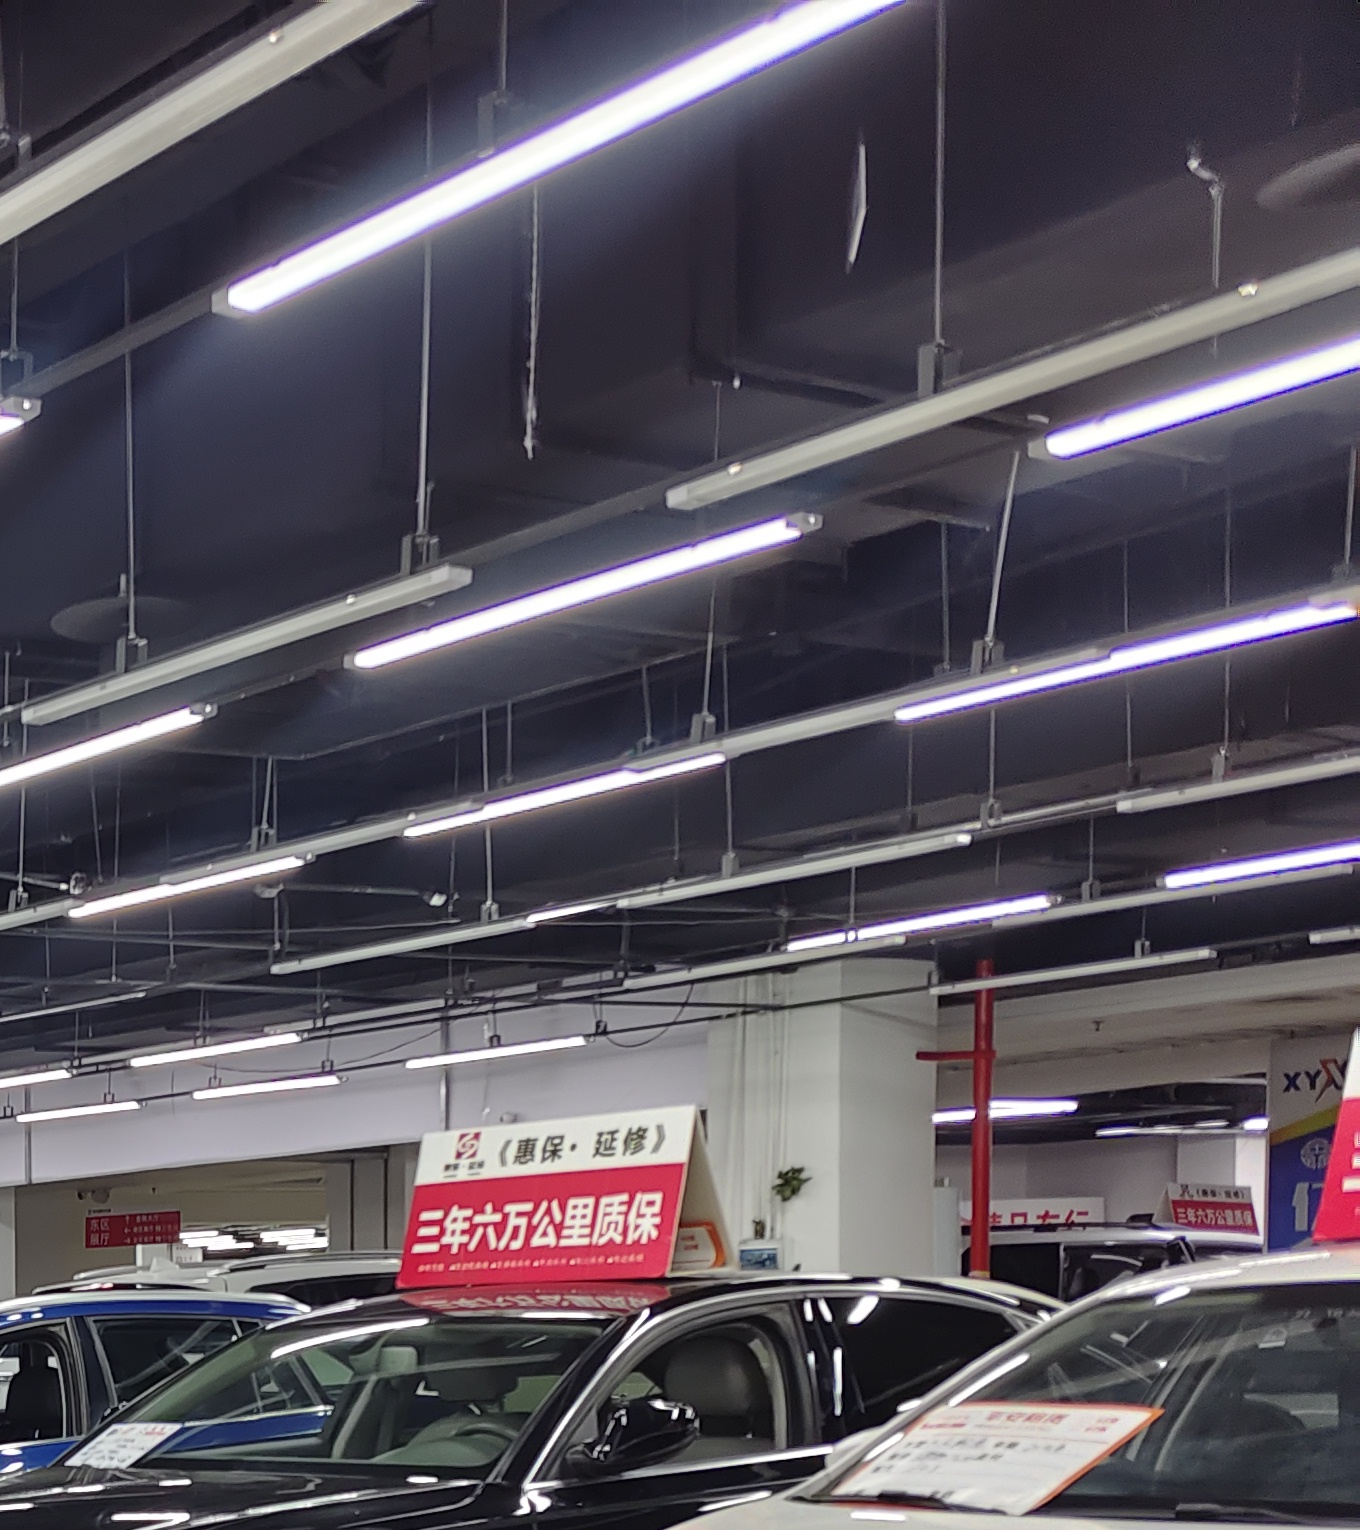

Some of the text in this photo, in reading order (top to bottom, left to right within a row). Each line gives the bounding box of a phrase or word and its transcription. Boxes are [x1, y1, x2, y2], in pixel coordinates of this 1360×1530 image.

[410, 1191, 663, 1254] 三年六万公里质保
